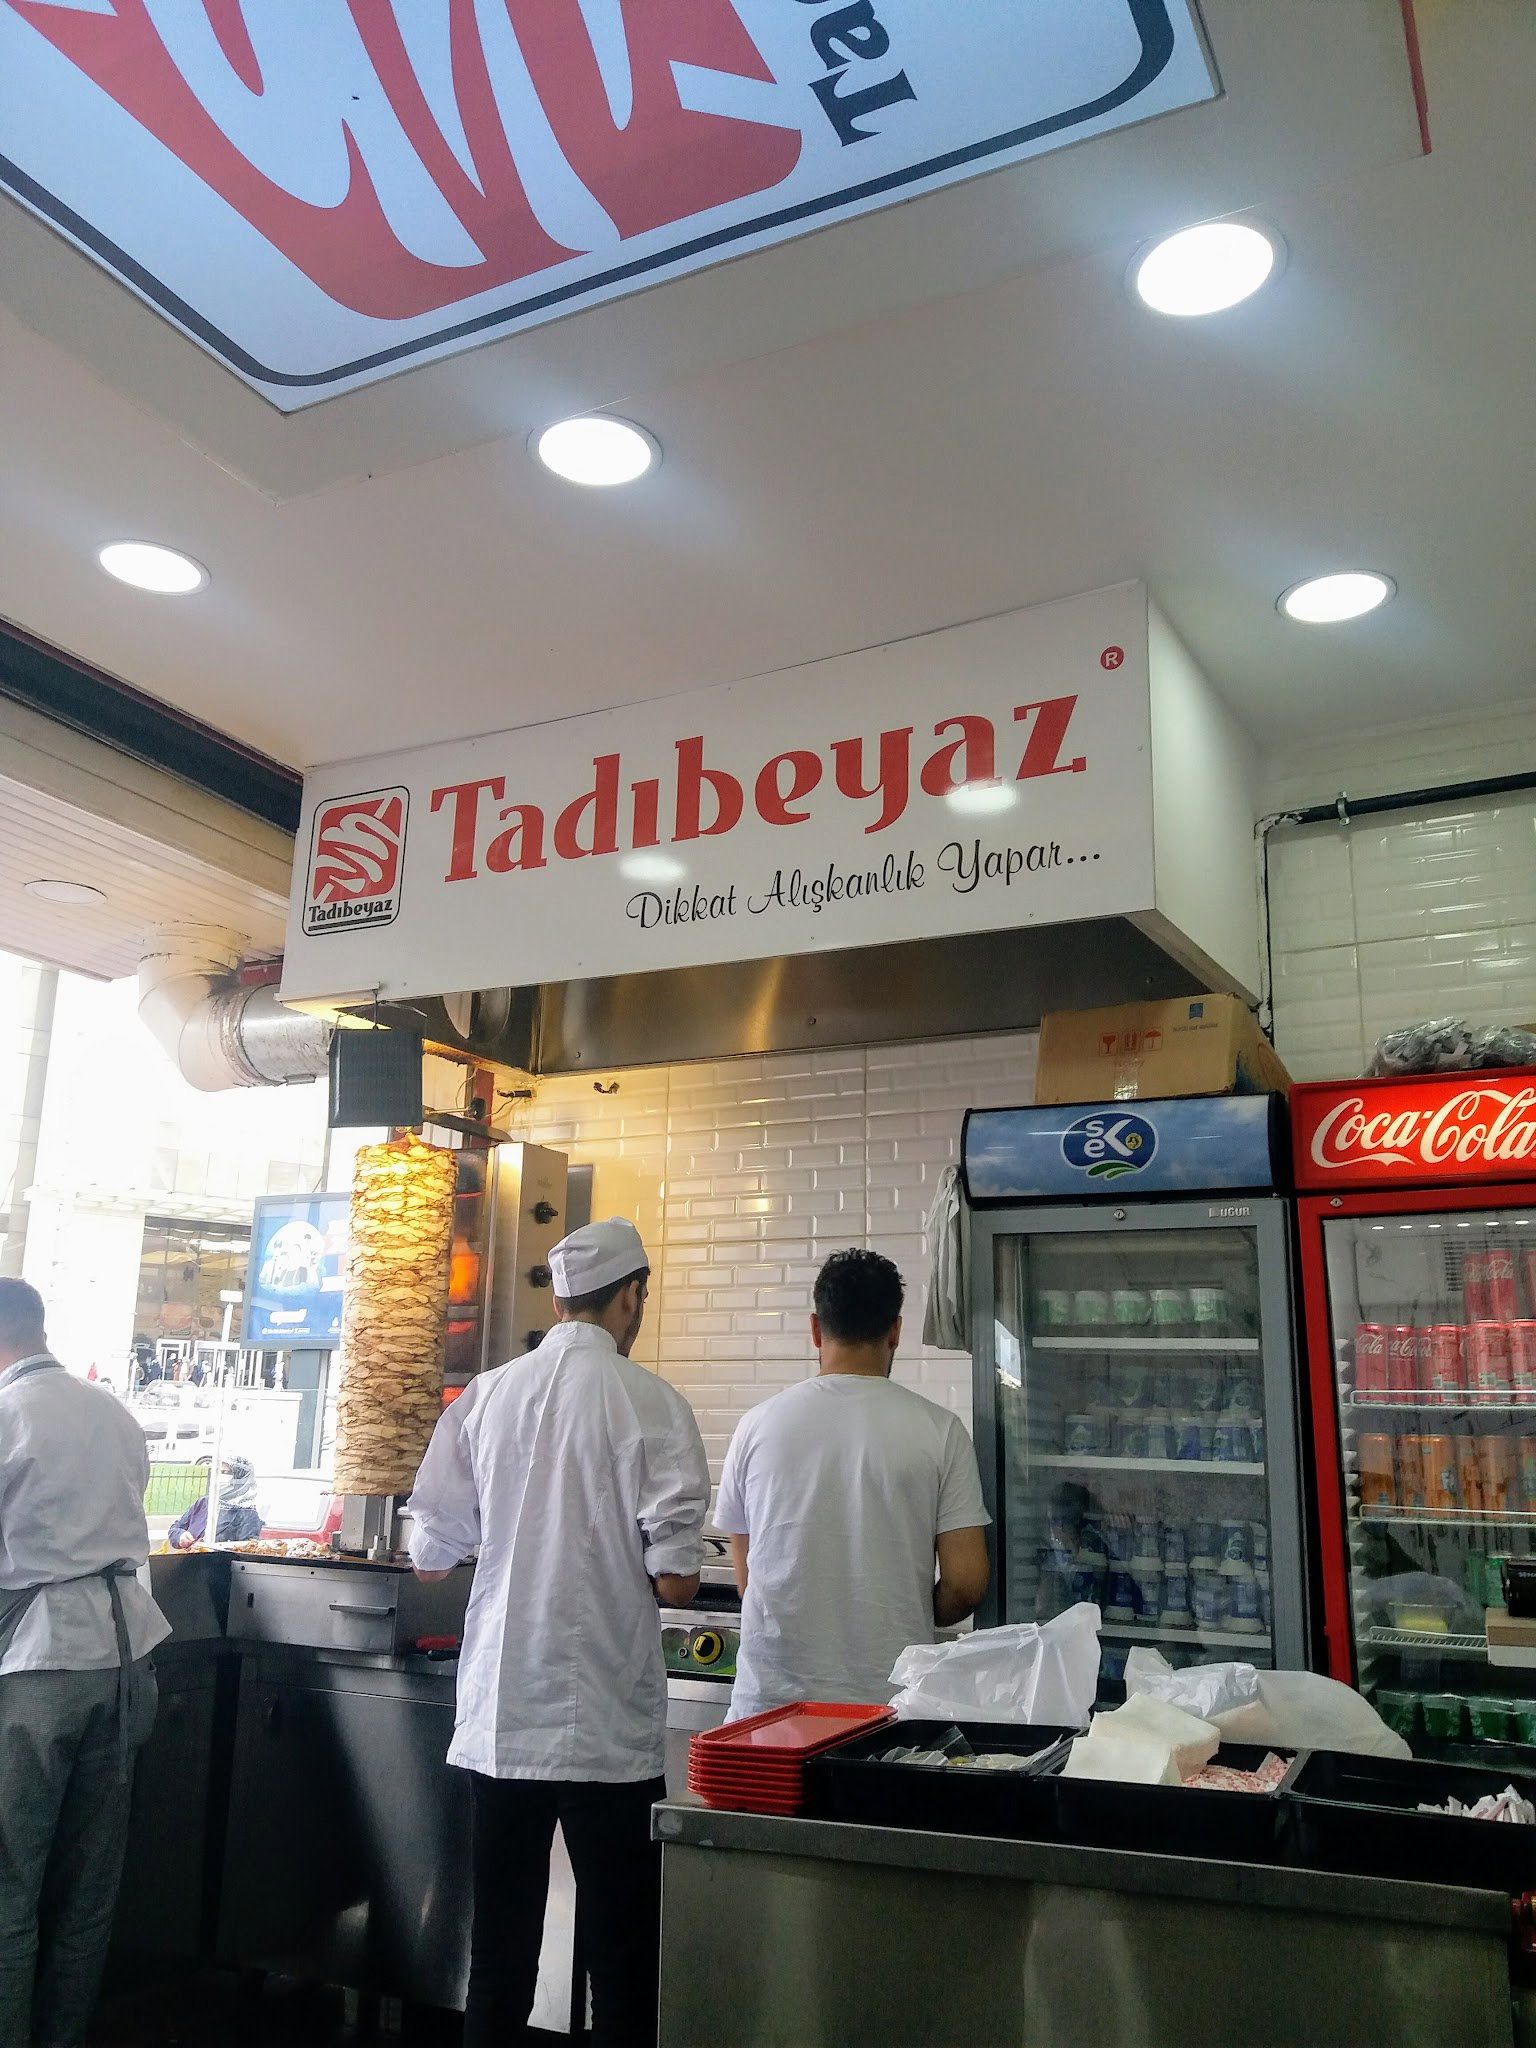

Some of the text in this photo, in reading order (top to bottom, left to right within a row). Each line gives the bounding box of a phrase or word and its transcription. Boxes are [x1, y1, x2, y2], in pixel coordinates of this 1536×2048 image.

[431, 694, 1086, 883] Tadıbeyaz
[308, 899, 393, 923] Tadıbeyaz
[625, 882, 738, 929] Dikkat
[747, 849, 926, 914] Alışkanlık
